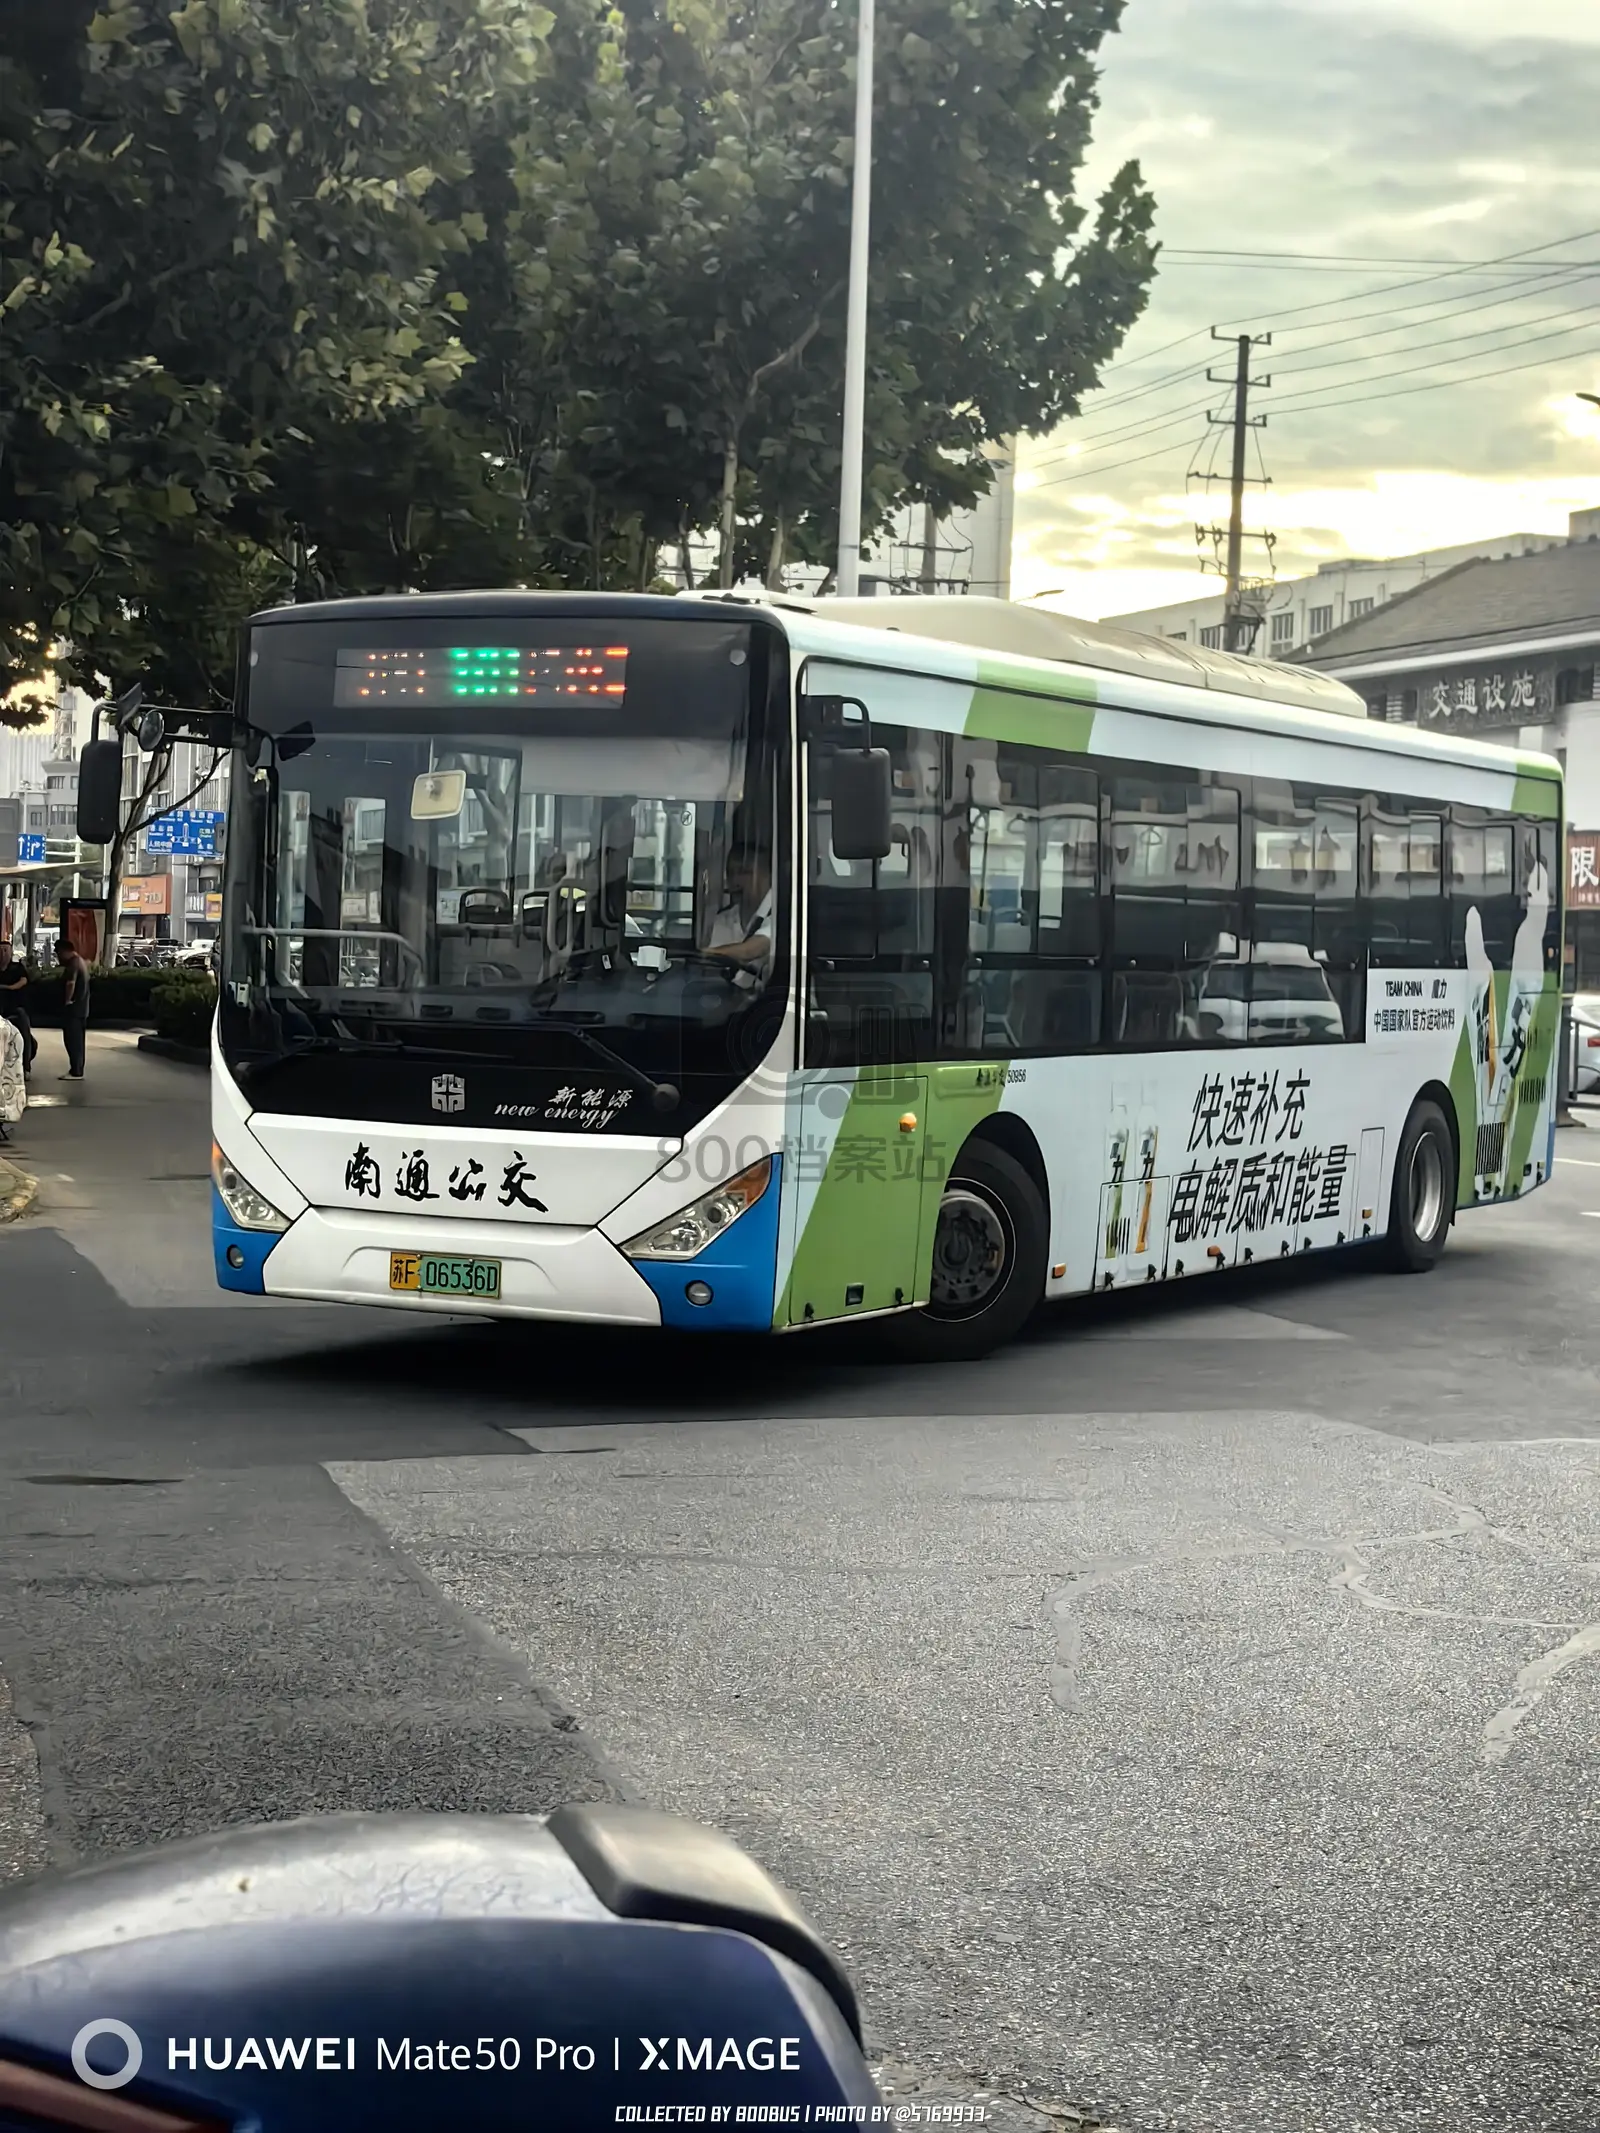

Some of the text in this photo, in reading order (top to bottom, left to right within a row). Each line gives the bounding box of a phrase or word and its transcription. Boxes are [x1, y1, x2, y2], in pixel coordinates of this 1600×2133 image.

[1429, 669, 1536, 719] 交通设施
[1385, 979, 1423, 998] TEAM CHINA
[1374, 1008, 1456, 1033] 中国国家队官方运动饮料
[494, 1102, 620, 1129] new energy
[548, 1086, 634, 1109] 新能源
[1187, 1069, 1311, 1152] 快速补充
[345, 1141, 549, 1214] 南通公交
[1167, 1144, 1348, 1244] 电解质和能量
